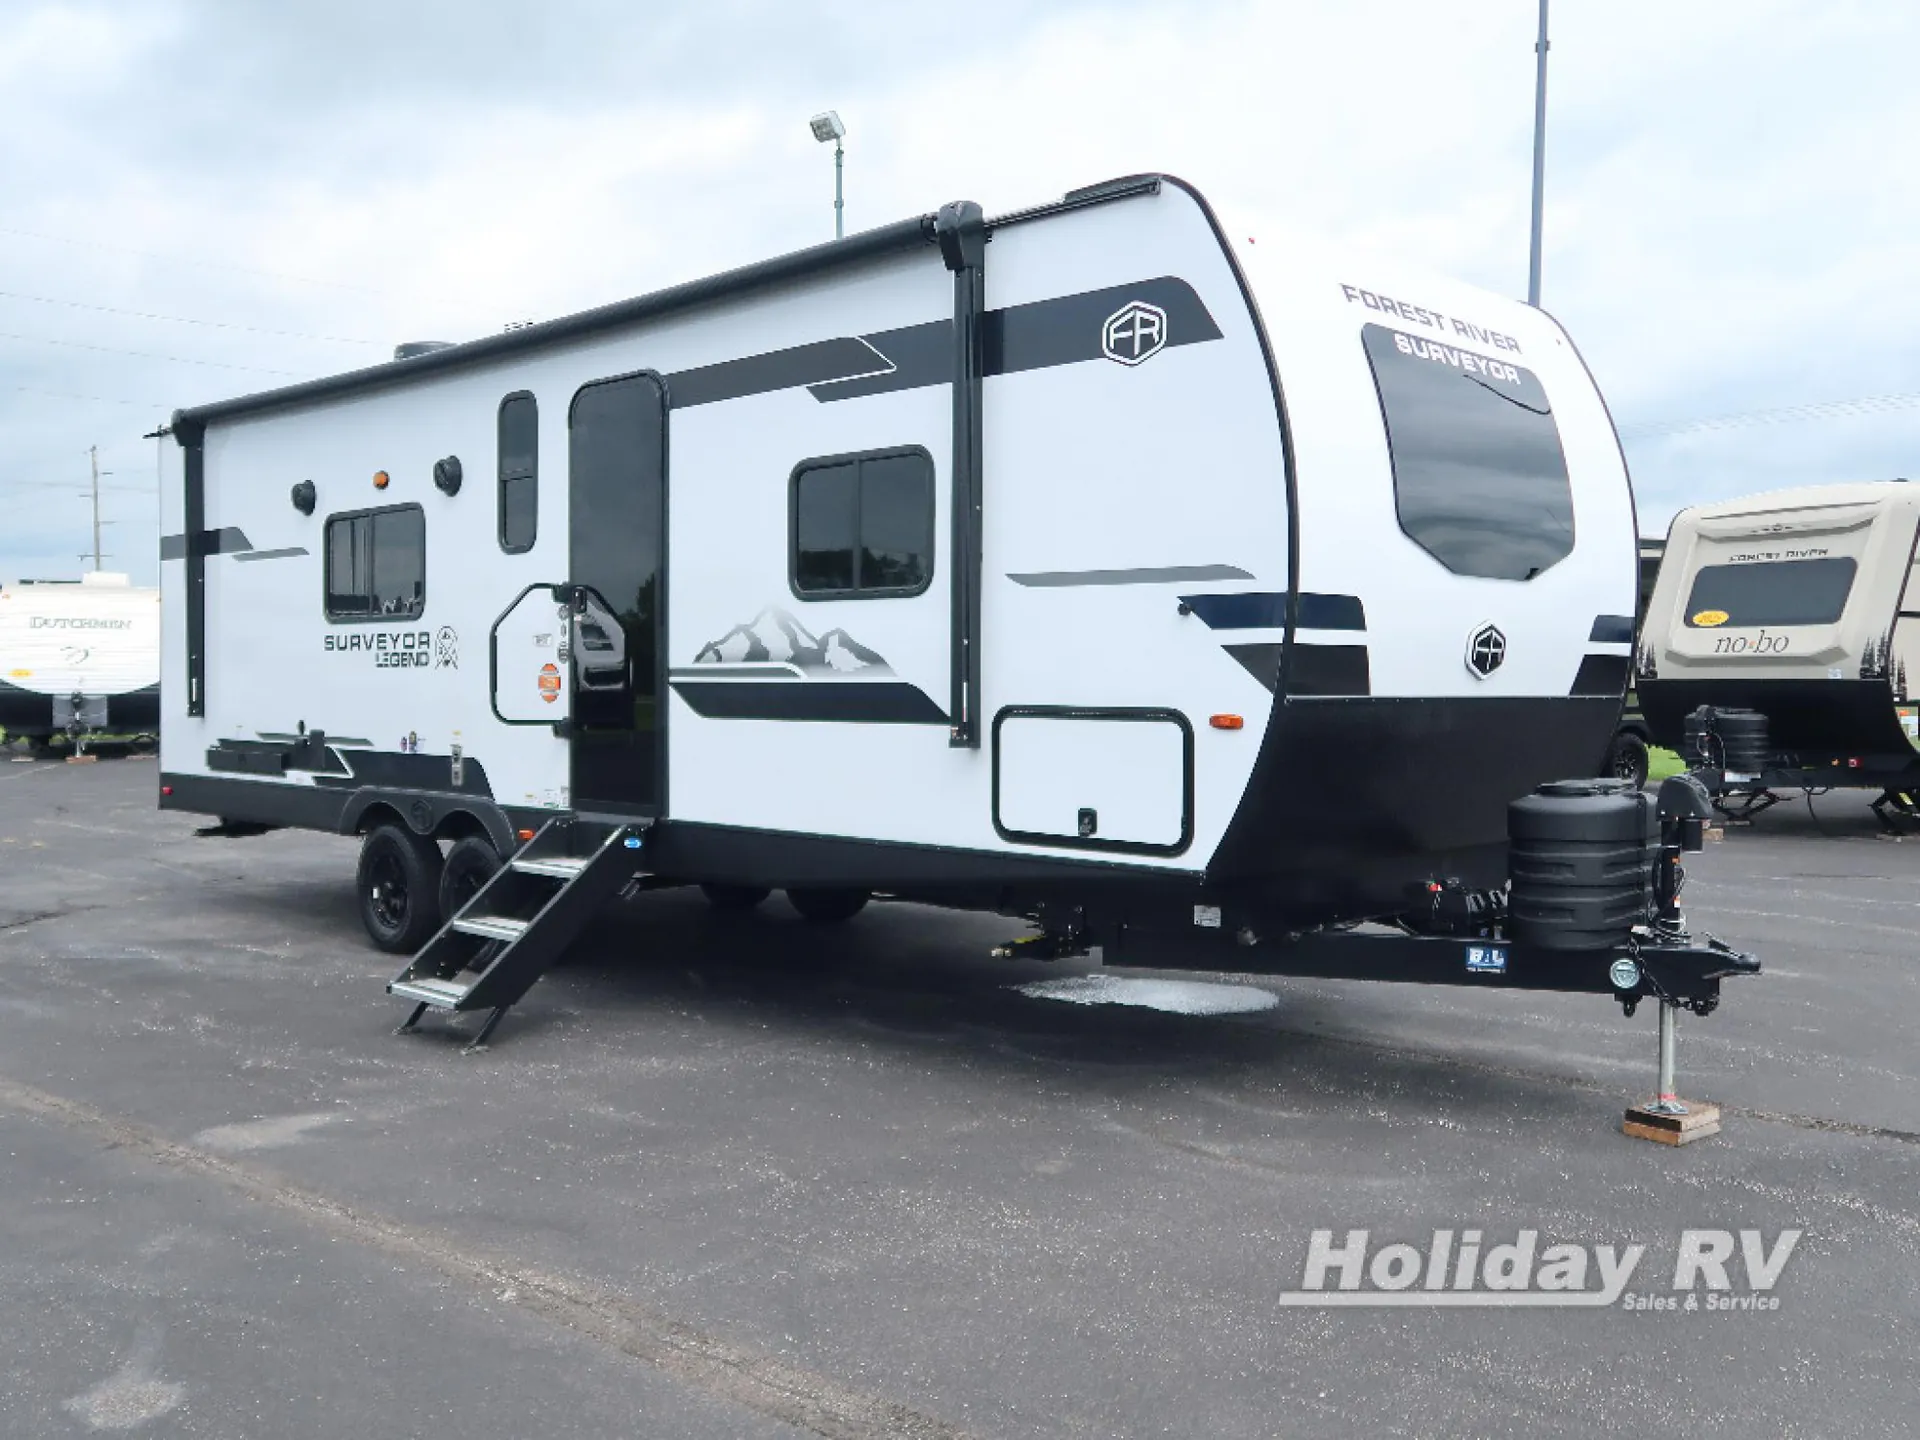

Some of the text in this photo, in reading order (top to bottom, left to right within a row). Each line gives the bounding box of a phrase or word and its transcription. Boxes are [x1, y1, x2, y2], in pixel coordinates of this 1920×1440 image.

[1340, 283, 1522, 354] FOREST RIVER
[1394, 332, 1522, 385] SURVEYOR
[29, 616, 132, 629] DUTCHMEN
[324, 632, 430, 651] SURVEYOR
[375, 652, 430, 668] LEGEND
